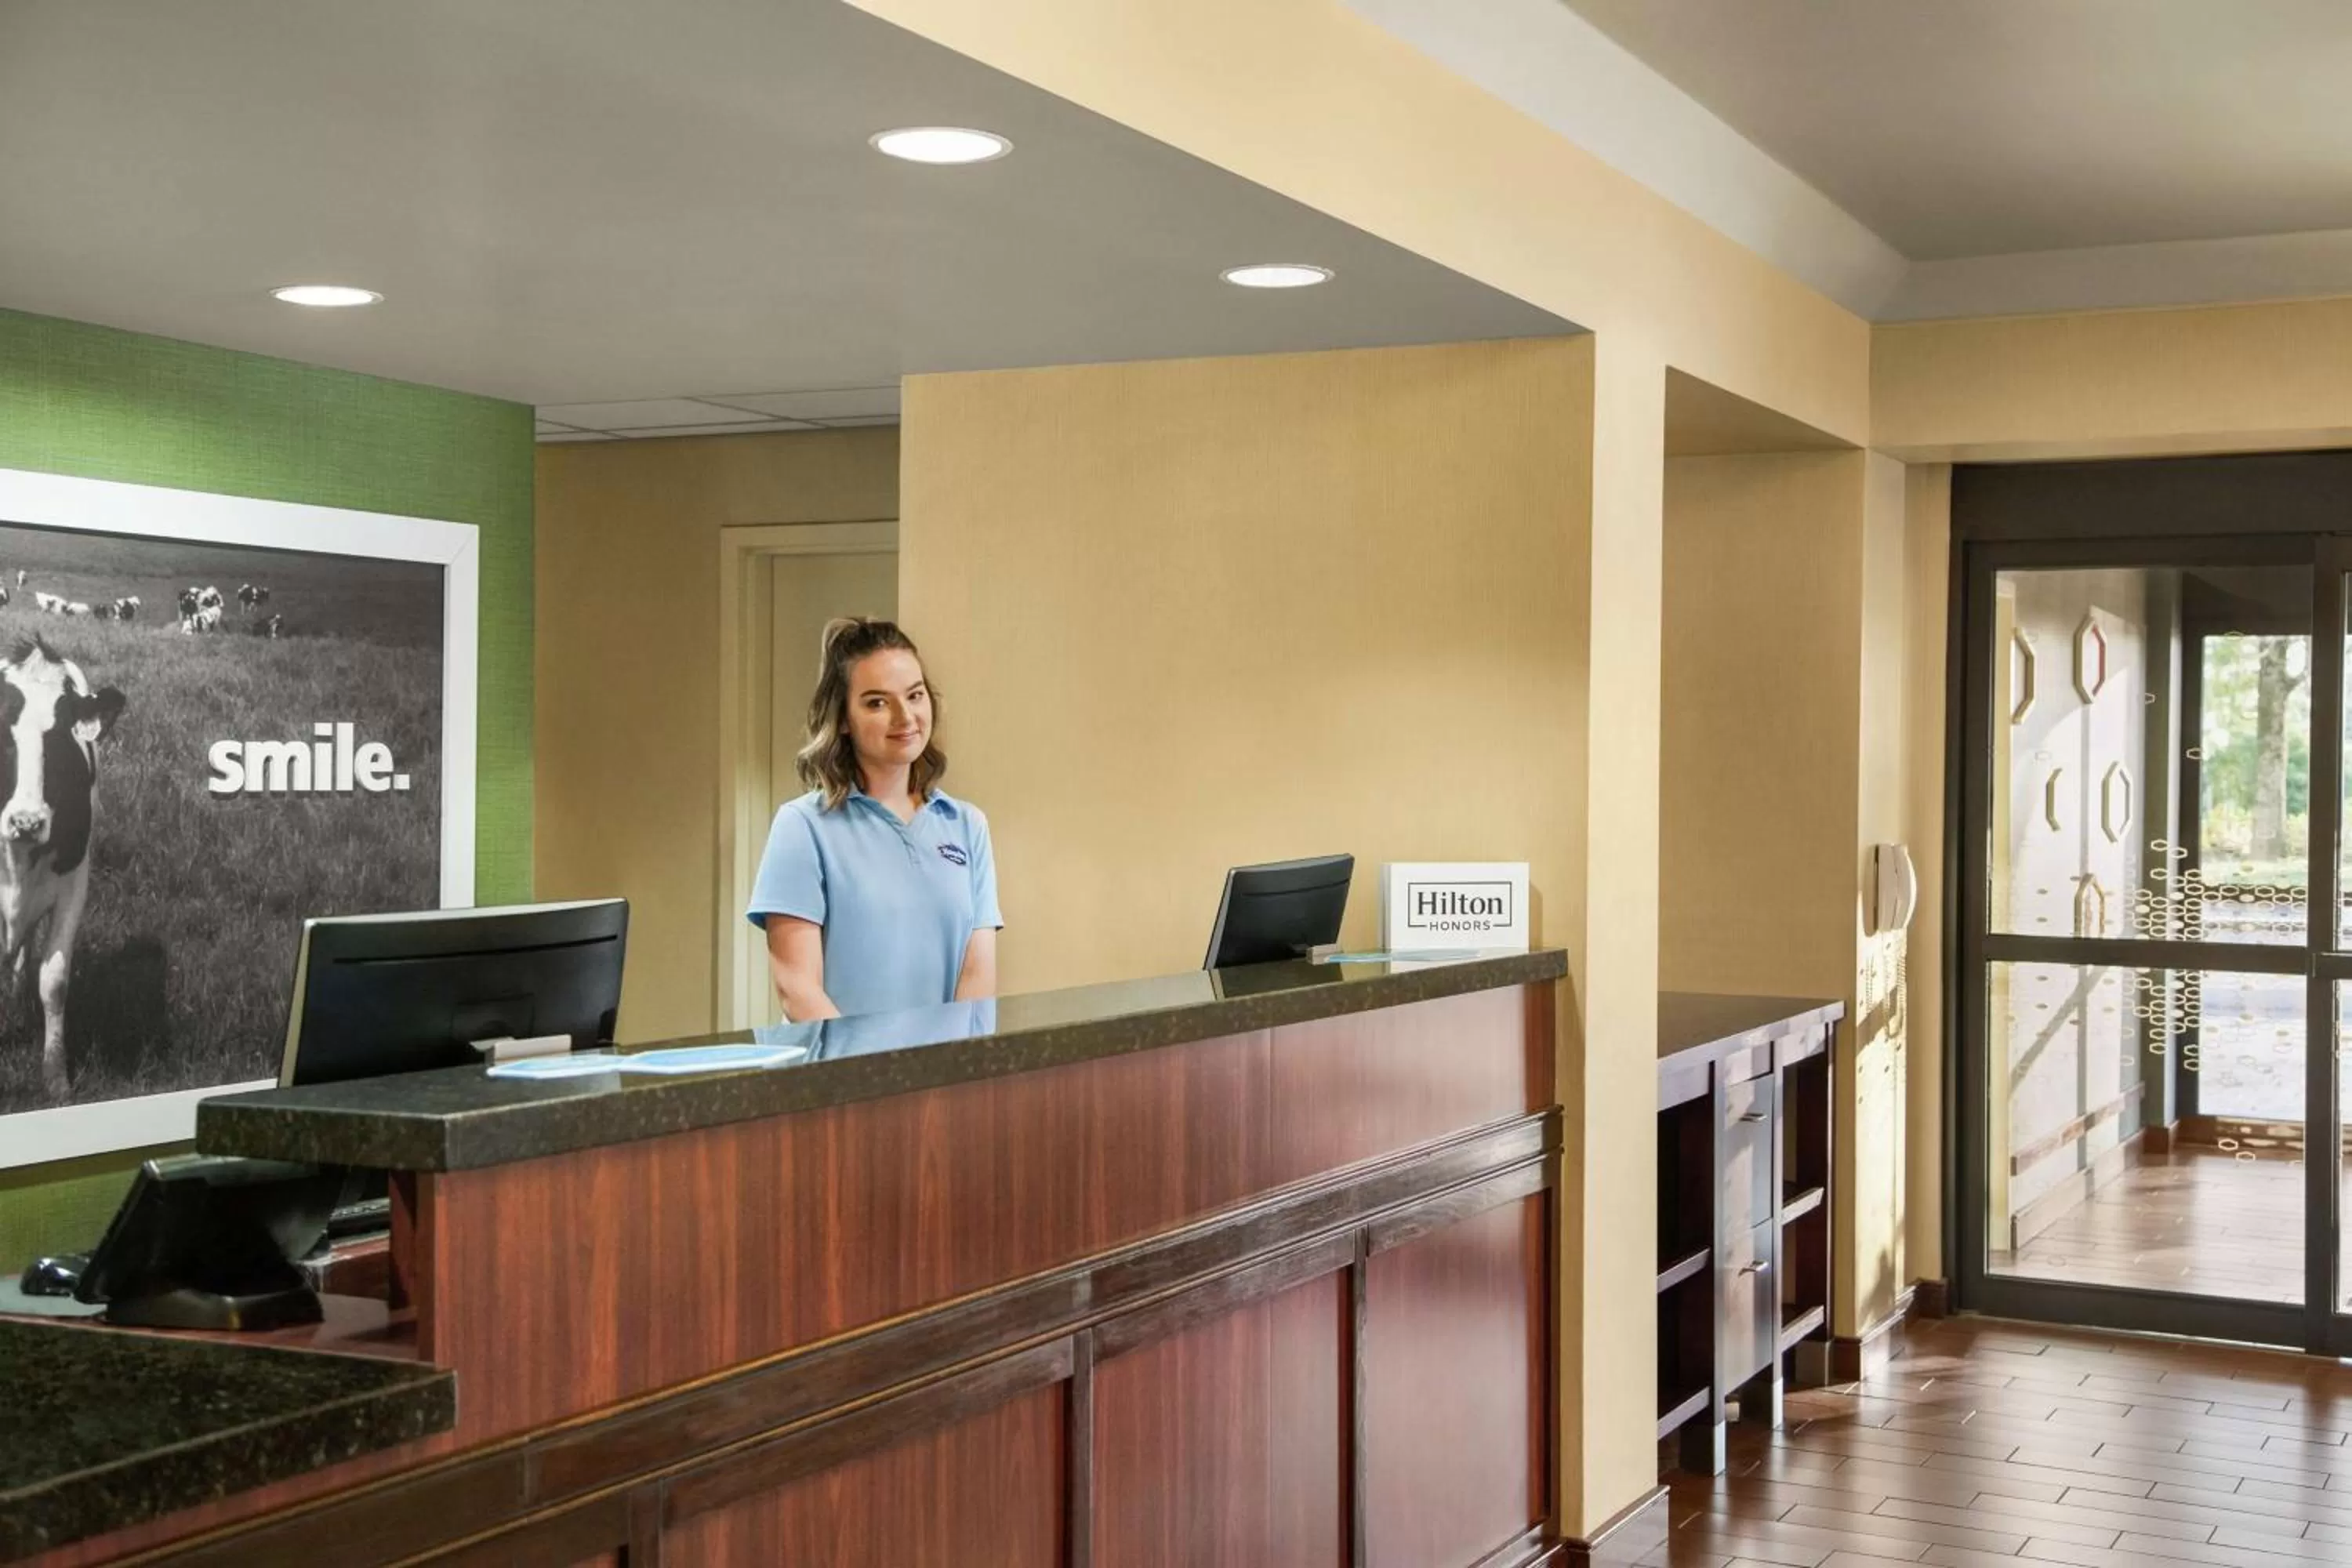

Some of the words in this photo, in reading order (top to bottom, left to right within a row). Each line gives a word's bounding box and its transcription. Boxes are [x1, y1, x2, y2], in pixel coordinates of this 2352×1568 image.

[208, 722, 410, 793] smile.
[1417, 891, 1503, 916] Hilton
[1429, 920, 1491, 931] HONORS
